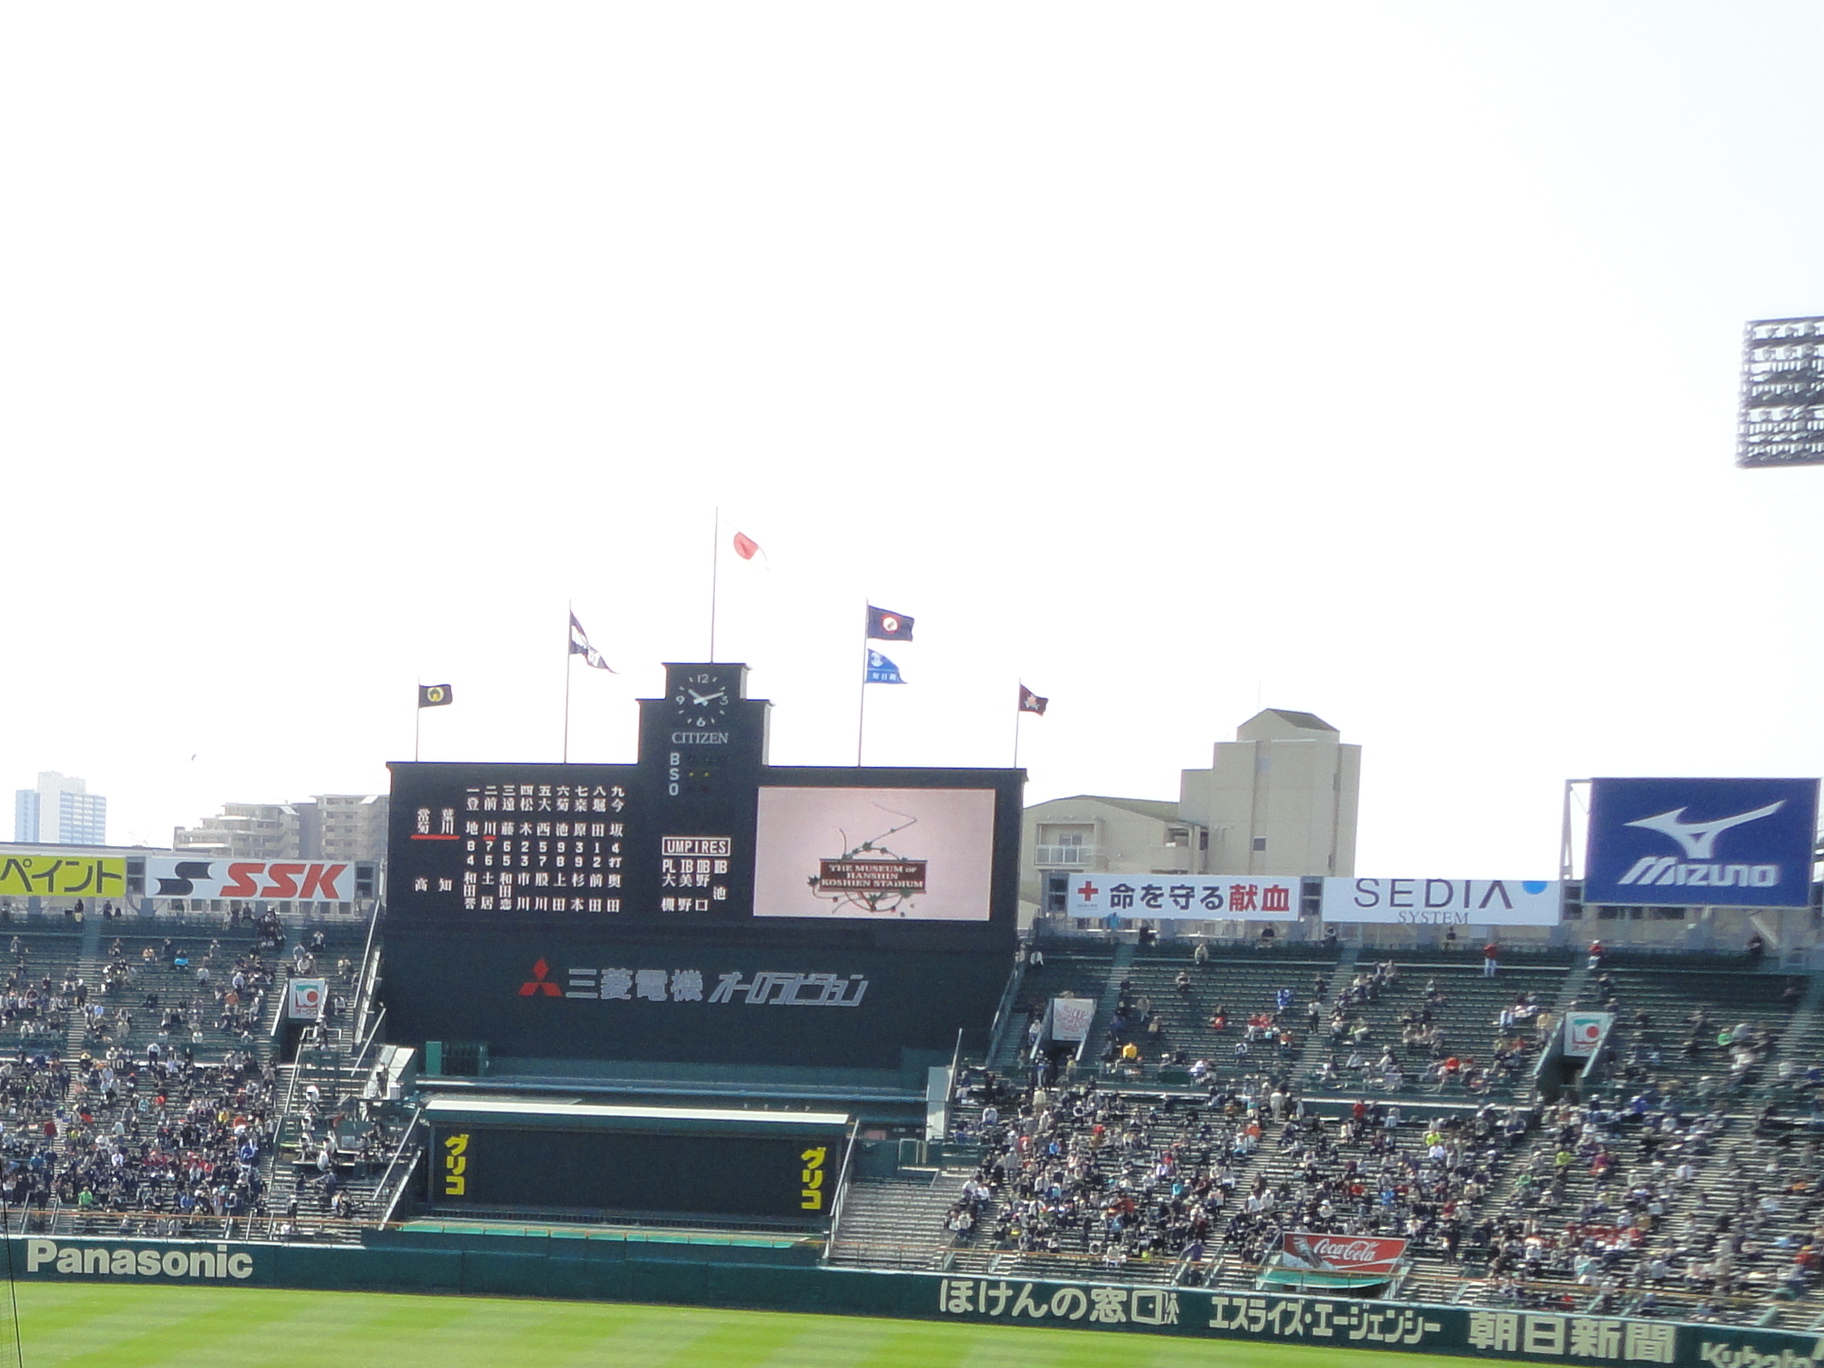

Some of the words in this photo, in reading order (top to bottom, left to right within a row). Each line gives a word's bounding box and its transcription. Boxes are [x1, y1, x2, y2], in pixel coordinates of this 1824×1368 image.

[697, 674, 709, 684] 12
[676, 696, 685, 705] 9
[696, 717, 706, 727] 6
[672, 732, 729, 744] CITIZEN
[670, 753, 680, 766] B
[669, 768, 680, 781] S
[485, 786, 498, 795] 二
[502, 785, 516, 796] 三
[520, 785, 534, 796] 四
[538, 785, 552, 796] 五
[556, 785, 570, 797] 六
[574, 785, 588, 797] 七
[592, 786, 607, 797] 八
[611, 786, 625, 797] 九
[467, 840, 476, 851] 8
[485, 841, 494, 852] 7
[503, 841, 512, 852] 6
[521, 841, 530, 852] 2
[539, 841, 548, 852] 5
[557, 842, 566, 853] 9
[575, 842, 584, 853] 3
[594, 842, 601, 853] 1
[611, 843, 620, 854] 4
[667, 840, 727, 854] UMPIRES
[466, 855, 475, 866] 4
[485, 855, 494, 866] 6
[502, 855, 511, 866] 5
[521, 856, 530, 867] 3
[539, 856, 548, 867] 7
[556, 856, 565, 867] 8
[575, 857, 584, 868] 9
[593, 857, 602, 868] 2
[609, 857, 622, 869] 打
[662, 860, 676, 873] PL
[829, 864, 853, 873] THE
[854, 865, 903, 873] MUSEUM
[219, 862, 352, 899] SSK
[846, 872, 899, 880] HANSHIN
[414, 878, 453, 892] 高知
[821, 879, 871, 887] KOSHIEN
[873, 880, 924, 888] STADIUM
[1108, 882, 1291, 914] 命を守る献血
[1398, 910, 1469, 926] SYSTEM
[565, 968, 704, 1002] 三菱電機
[445, 1134, 470, 1196] グリコ
[800, 1147, 827, 1210] グリコ
[27, 1240, 254, 1279] Panasonic
[939, 1279, 1162, 1325] ほけんの窓口
[1209, 1296, 1442, 1344] エスライズ・エージェンシー
[1468, 1312, 1675, 1364] 朝日新聞
